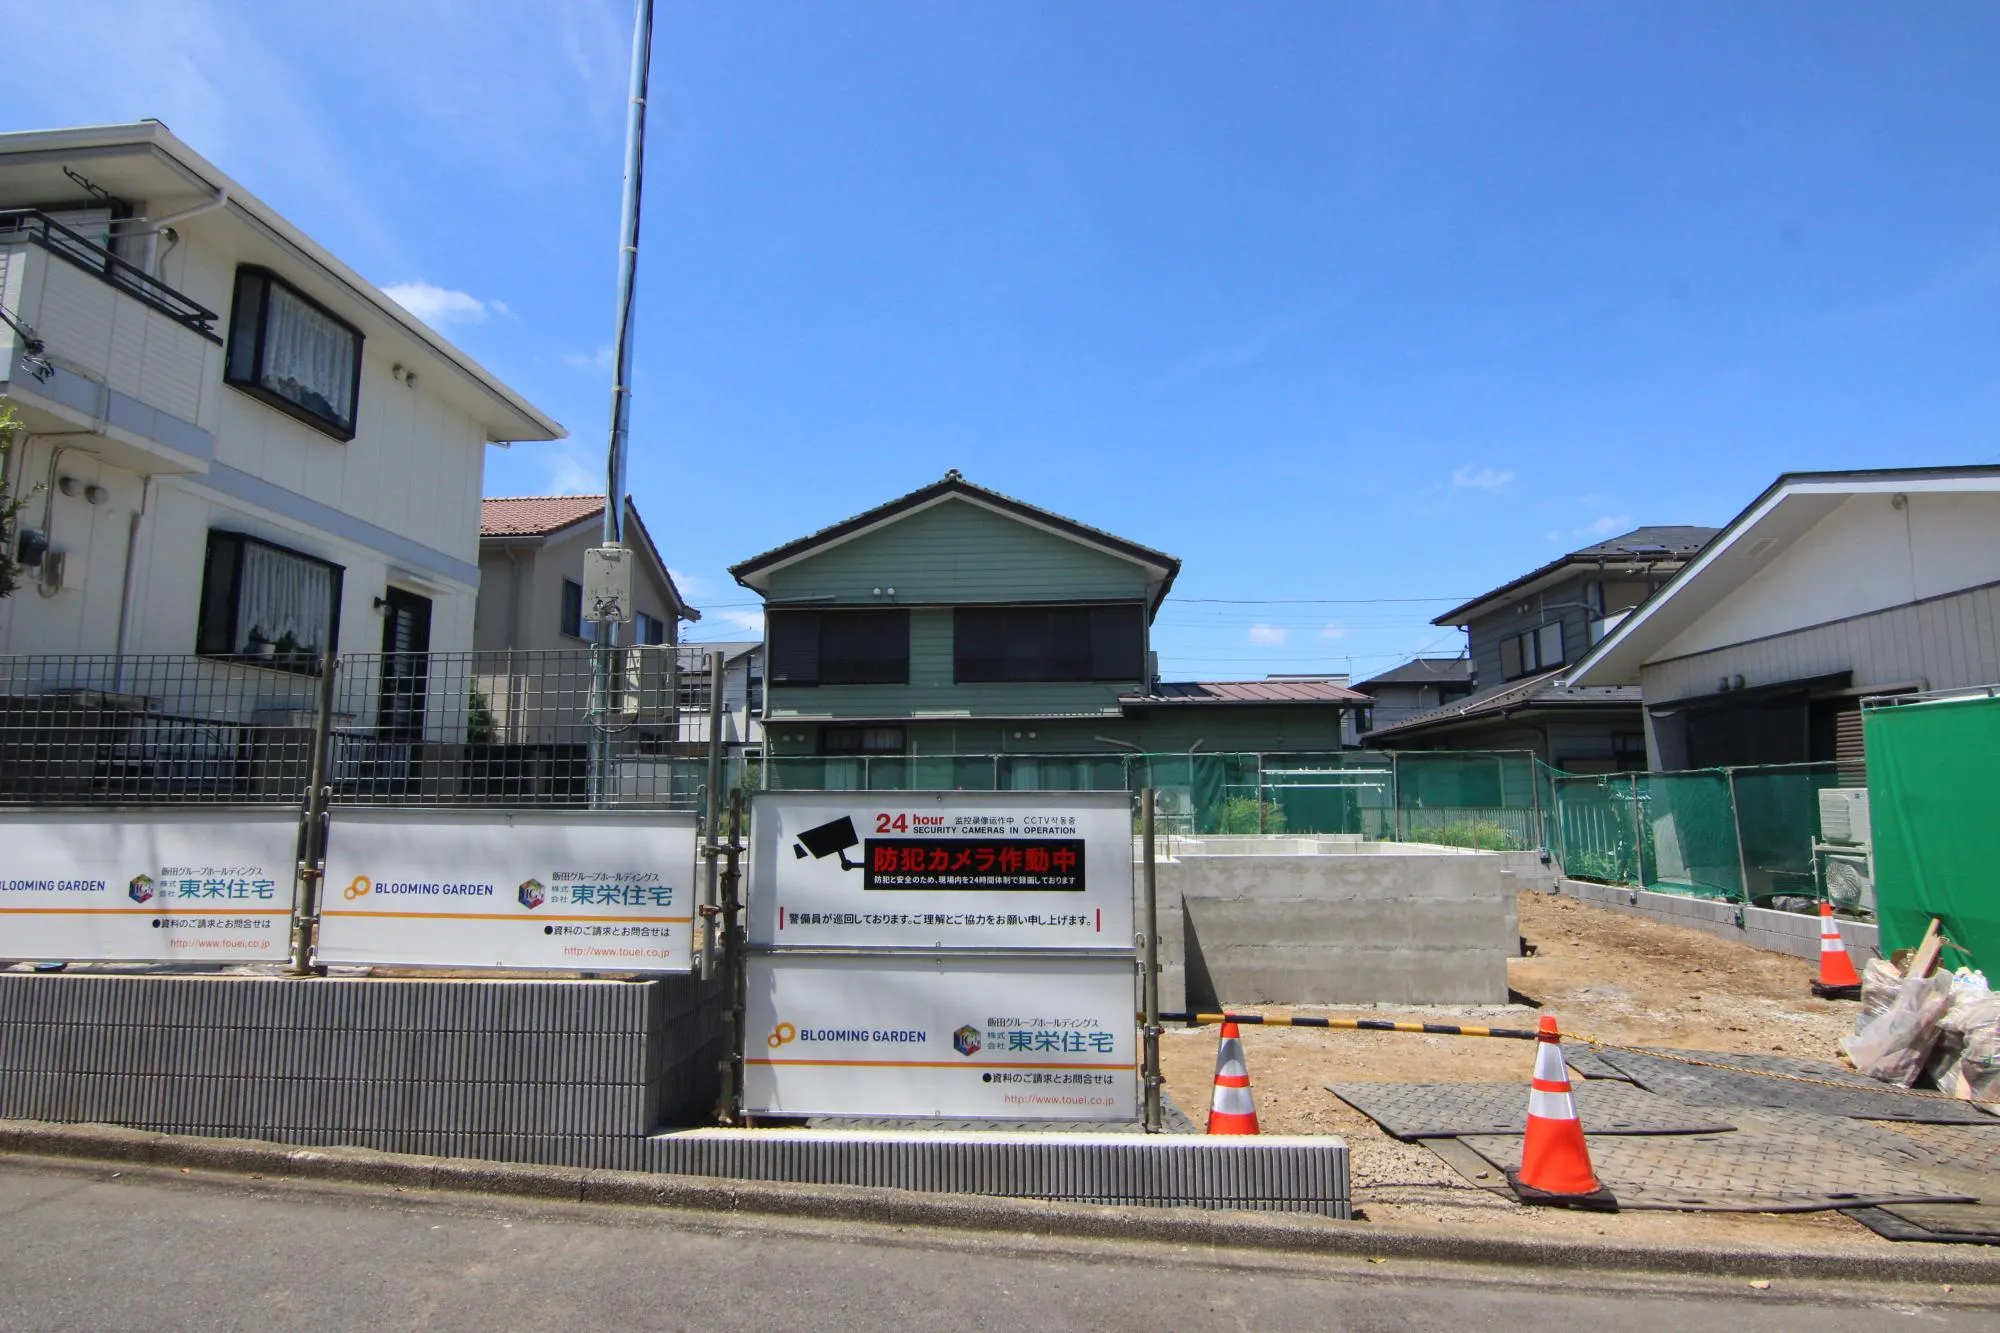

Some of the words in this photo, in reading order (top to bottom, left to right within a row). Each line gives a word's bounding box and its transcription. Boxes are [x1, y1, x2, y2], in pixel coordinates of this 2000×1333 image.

[876, 813, 908, 833] 24
[913, 814, 945, 825] hour
[874, 848, 1076, 872] 防犯カメラ作動中
[58, 880, 105, 891] GARDEN
[178, 879, 275, 900] 東栄住宅
[375, 882, 440, 895] BLOOMING
[442, 883, 494, 896] GARDEN
[571, 884, 673, 906] 東栄住宅
[170, 938, 270, 949] http://www.touei.co.jp
[564, 945, 670, 958] http://www.touei.co.jp
[800, 1029, 869, 1042] BLOOMING
[872, 1030, 926, 1043] GARDEN
[1008, 1031, 1114, 1052] 東栄住宅
[1004, 1093, 1114, 1106] http://www.touei.co.jp
